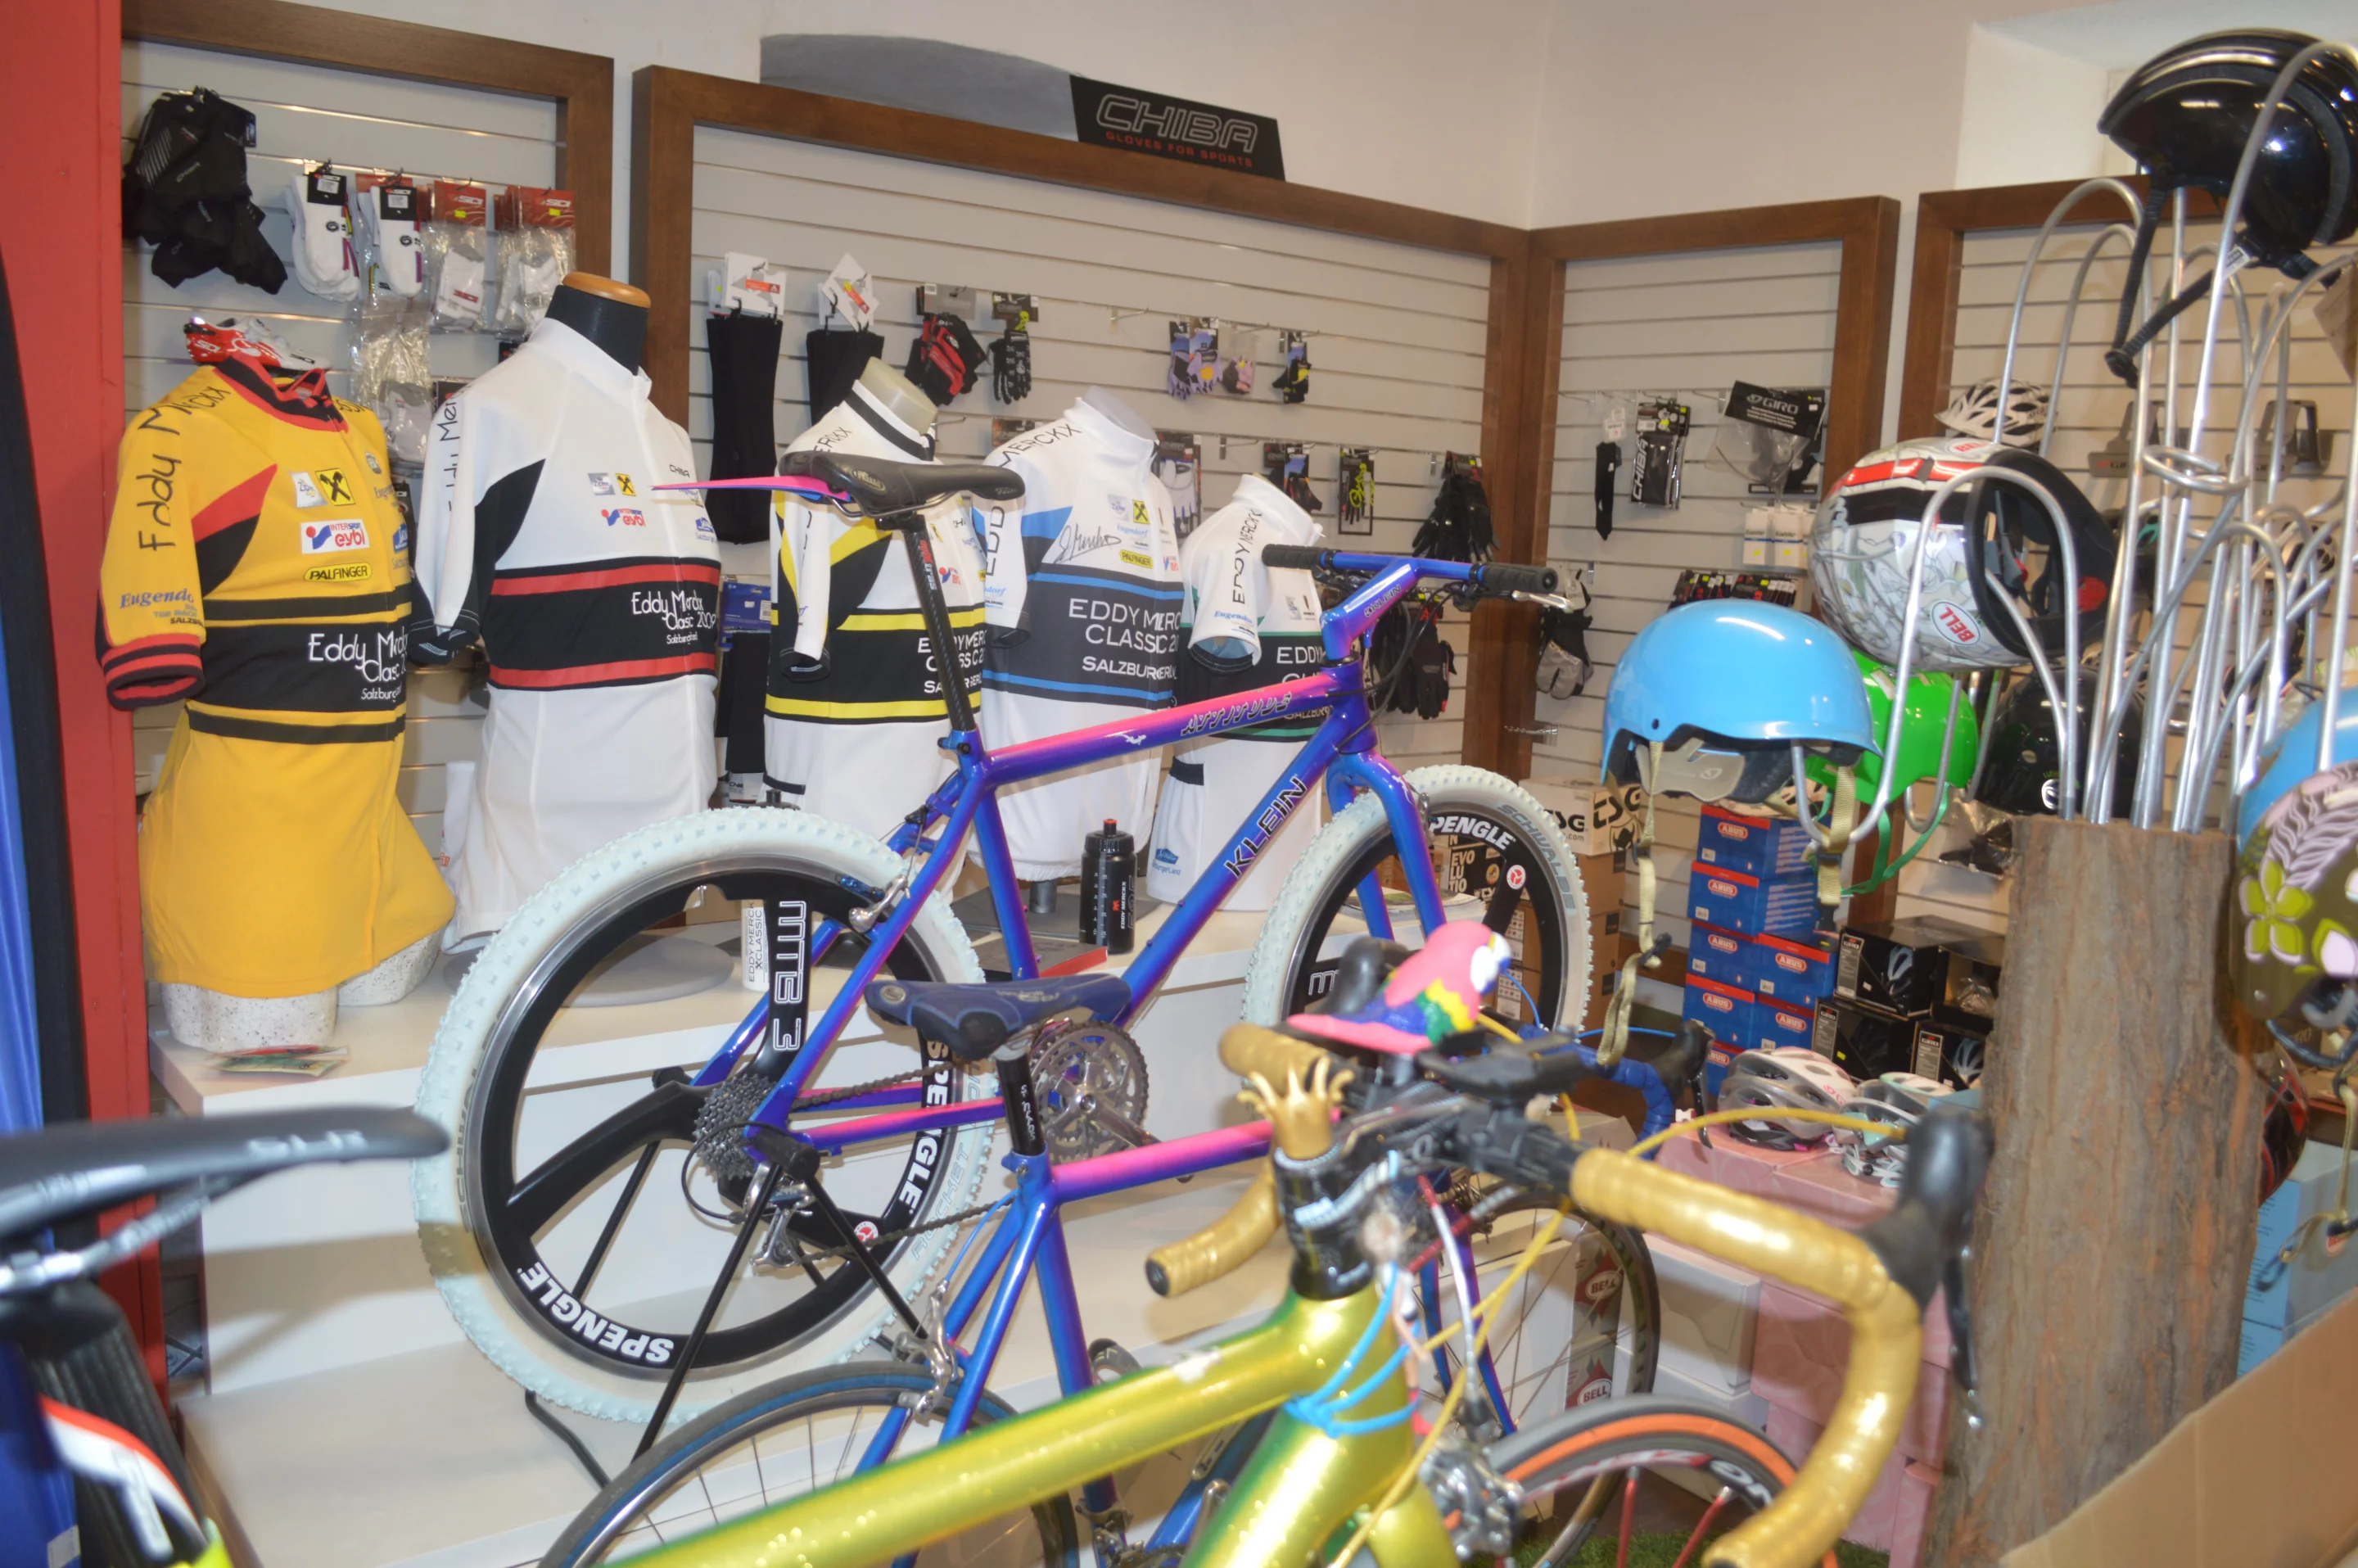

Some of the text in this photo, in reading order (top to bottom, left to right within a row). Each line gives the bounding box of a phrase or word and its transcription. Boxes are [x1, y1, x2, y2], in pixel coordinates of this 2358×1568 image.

[1096, 93, 1258, 154] CHIBA
[1105, 130, 1253, 168] GLOVES FOR SPORTS
[457, 195, 484, 206] SIDI
[545, 198, 571, 208] SIDI
[194, 340, 221, 354] SIDI
[1762, 397, 1799, 415] GIRO
[669, 464, 690, 478] CHIBA
[1633, 438, 1648, 501] CHIBA
[622, 513, 646, 526] eybl
[334, 528, 365, 547] eybl
[1122, 551, 1152, 567] PALFINGER
[309, 565, 368, 581] PALFINGER
[1369, 584, 1402, 610] KLEIN
[631, 591, 668, 621] Eddy
[1068, 598, 1140, 626] EDDY
[1939, 605, 1976, 643] BELL
[1085, 623, 1168, 654] CLASSIC
[308, 633, 366, 670] Eddy
[1224, 775, 1308, 879] KLEIN
[1428, 816, 1515, 851] PENGLE
[1721, 824, 1746, 836] ABUS
[1452, 850, 1475, 866] EVO
[1497, 803, 1577, 910] SCHWALBE
[1450, 865, 1465, 880] LU
[1448, 878, 1467, 893] TIO
[1711, 881, 1734, 893] ABUS
[1711, 936, 1734, 949] ABUS
[1843, 941, 1859, 950] GIRO
[1778, 956, 1803, 969] ABUS
[773, 901, 807, 1051] MTB 3
[1706, 995, 1729, 1008] ABUS
[1778, 1014, 1803, 1028] ABUS
[1921, 1037, 1940, 1046] GIRO
[899, 1041, 950, 1209] SPEGLE
[1591, 1277, 1616, 1294] BELL
[519, 1261, 675, 1363] SPENGLE
[1583, 1385, 1607, 1403] BELL
